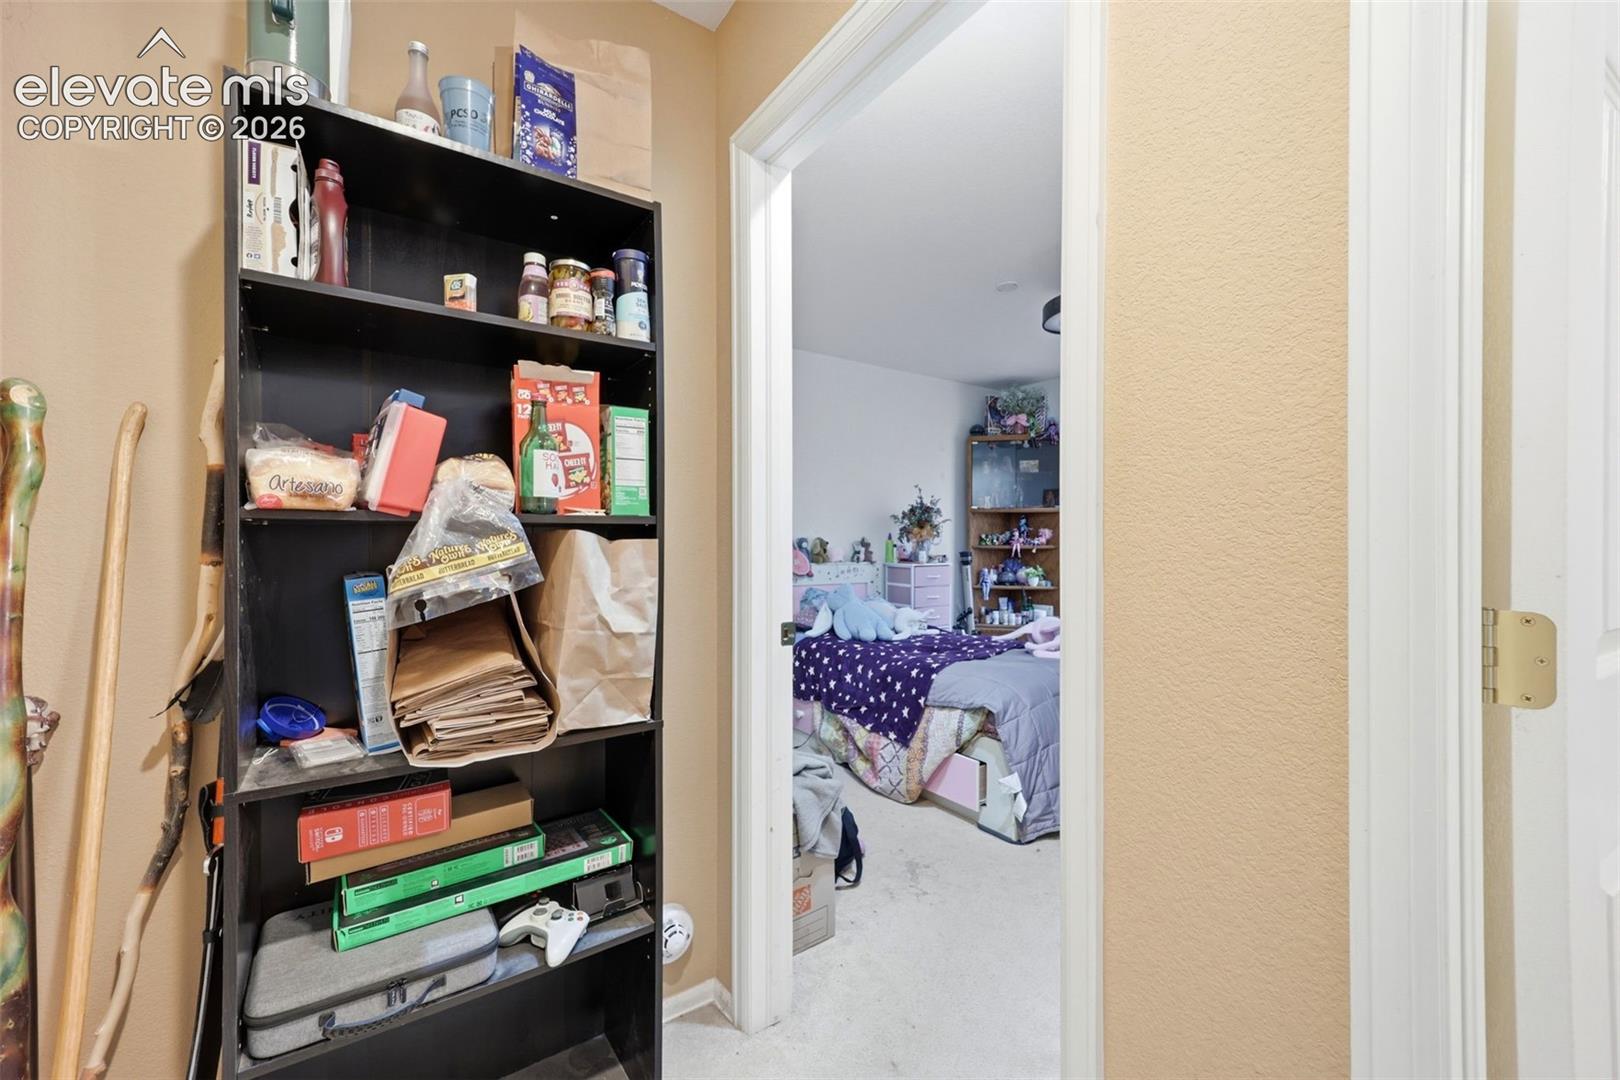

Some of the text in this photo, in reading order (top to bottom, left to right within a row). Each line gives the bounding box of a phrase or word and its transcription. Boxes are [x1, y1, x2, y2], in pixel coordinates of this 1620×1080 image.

[450, 108, 479, 119] PCSO
[517, 403, 532, 414] 12
[268, 474, 344, 496] Artesano
